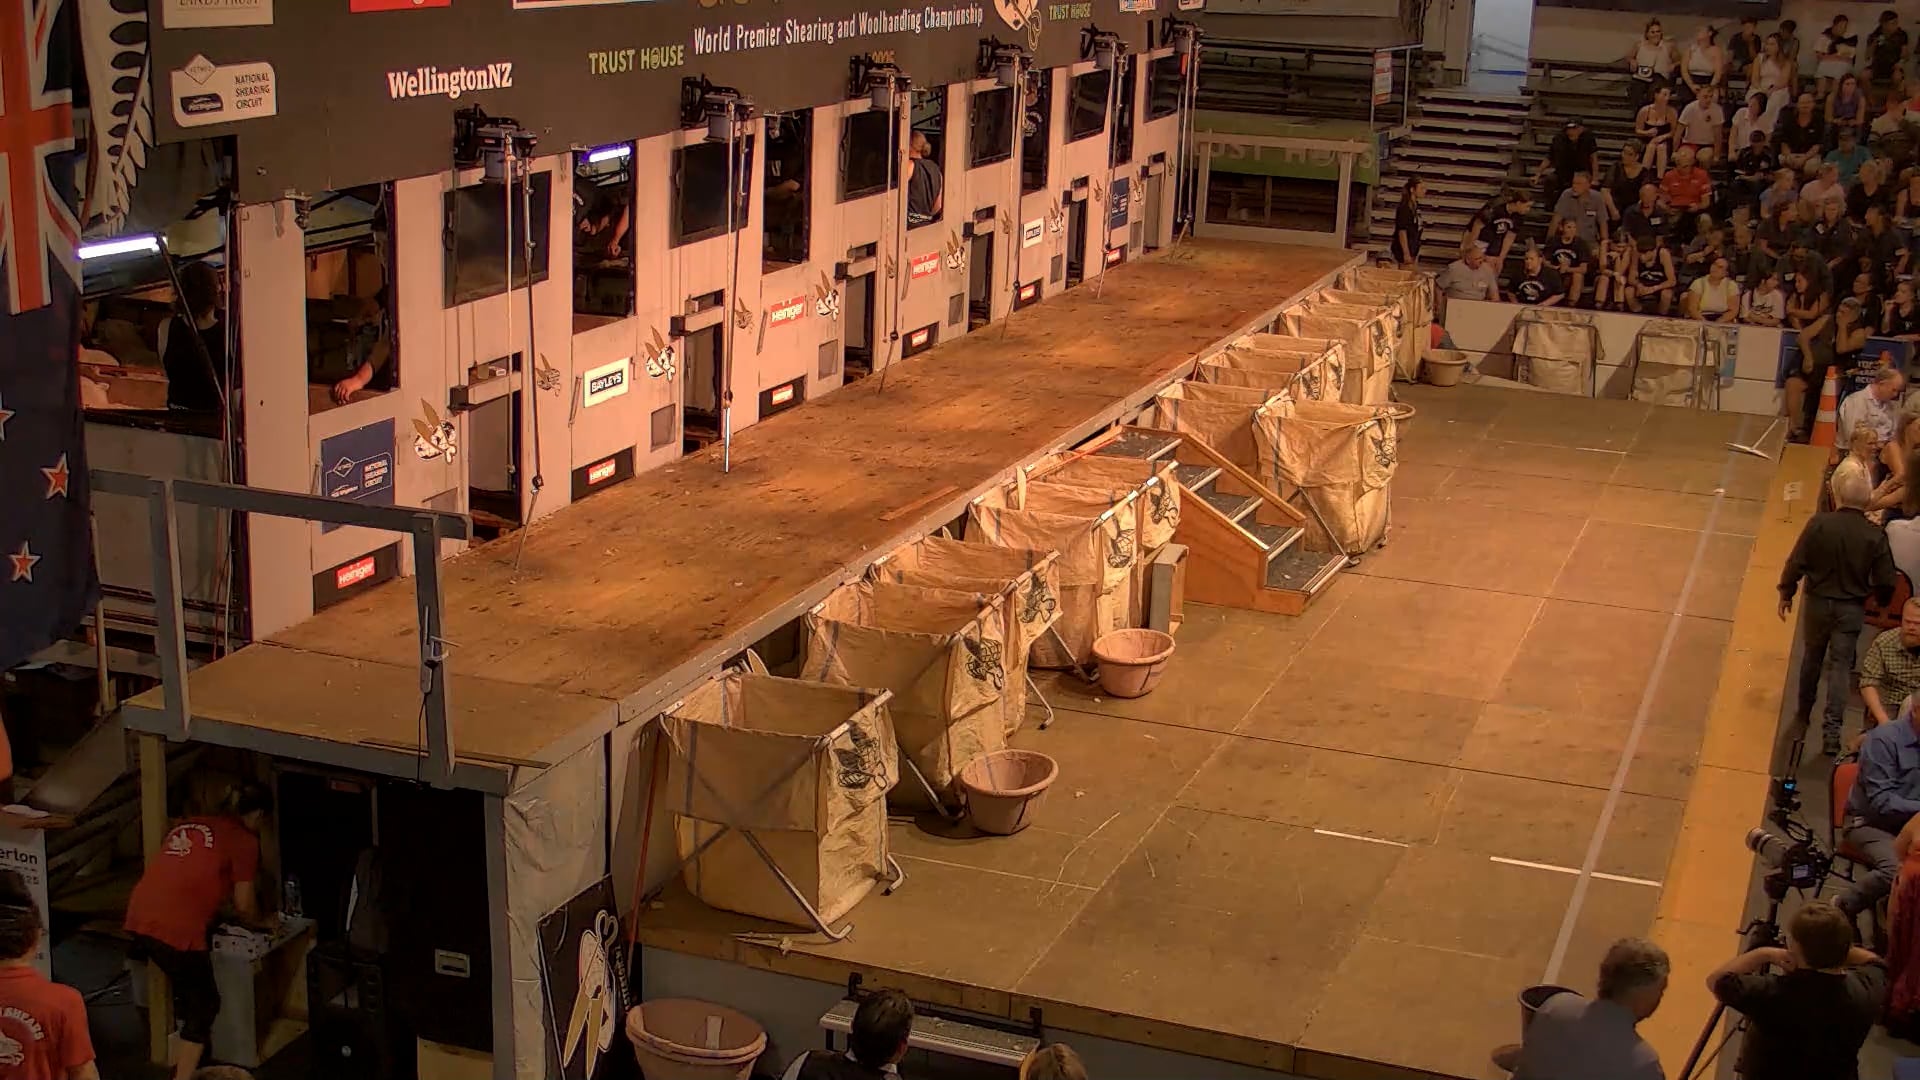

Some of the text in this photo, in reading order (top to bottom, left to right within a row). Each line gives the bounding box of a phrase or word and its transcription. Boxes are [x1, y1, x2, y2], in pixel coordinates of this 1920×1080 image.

[1048, 5, 1070, 20] TRUST
[694, 3, 983, 55] World Premier Shearing and Woolhandling Championship
[588, 45, 684, 75] TRUST HOUSE
[235, 72, 270, 84] NATIONAL
[387, 62, 513, 100] WellingtonNZ
[235, 84, 271, 97] SHEARING
[235, 98, 262, 109] CIRCUIT
[591, 373, 623, 393] BAYLEYS
